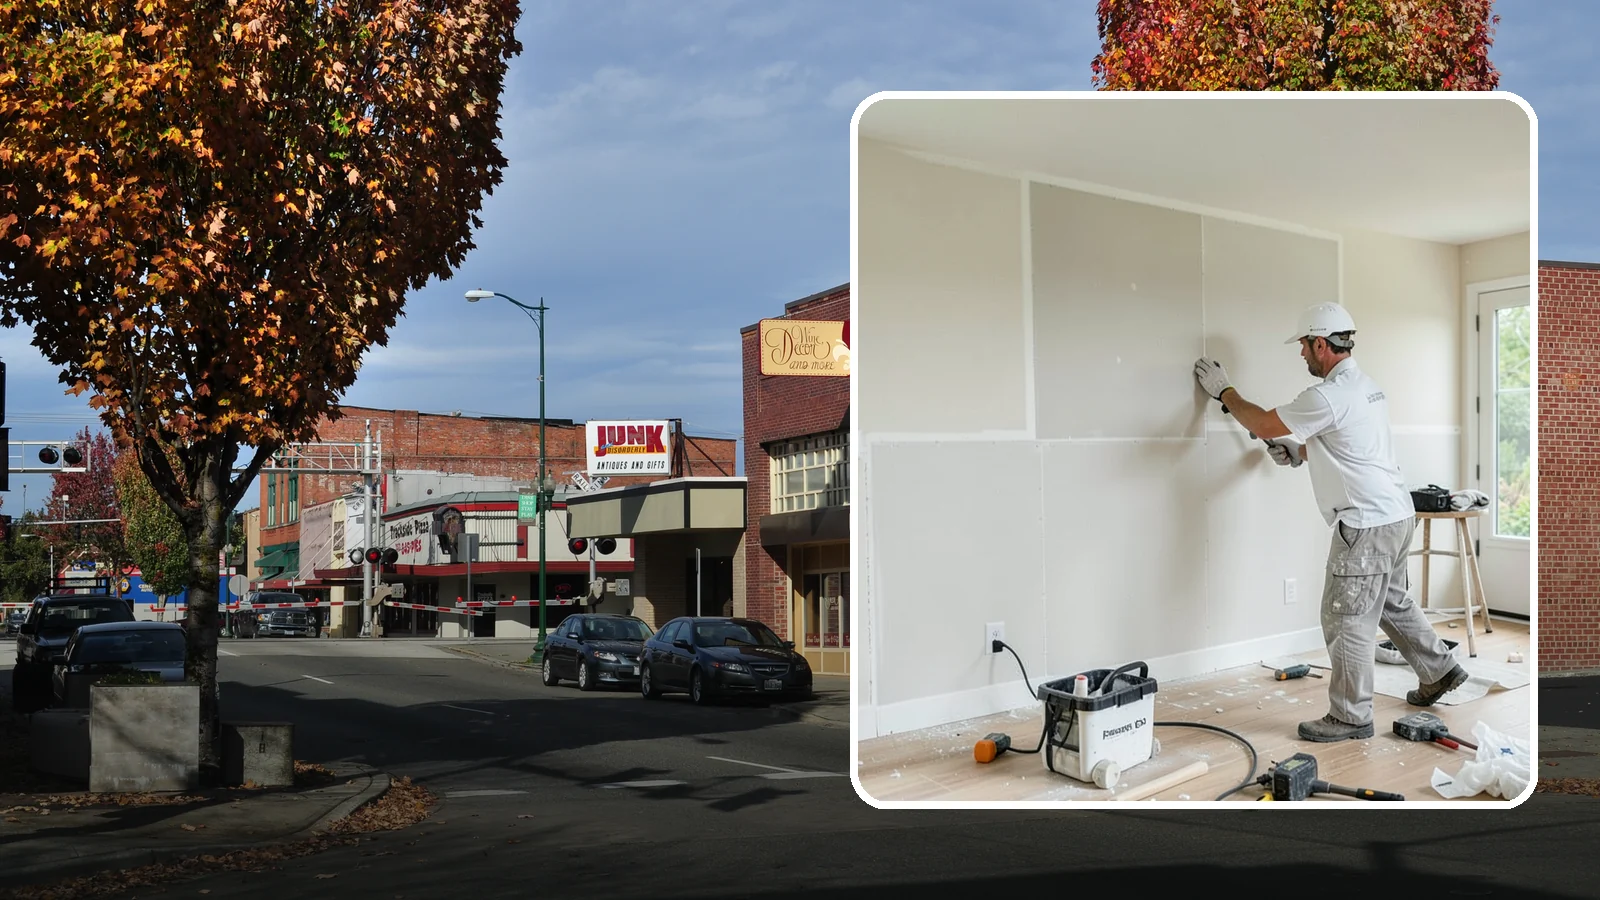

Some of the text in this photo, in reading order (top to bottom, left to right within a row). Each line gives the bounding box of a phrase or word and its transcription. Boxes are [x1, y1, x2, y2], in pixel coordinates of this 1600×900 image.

[595, 425, 665, 457] JUNK
[597, 460, 665, 470] ANTIQUES AND GIFTS
[390, 519, 429, 540] Trackside Pizza
